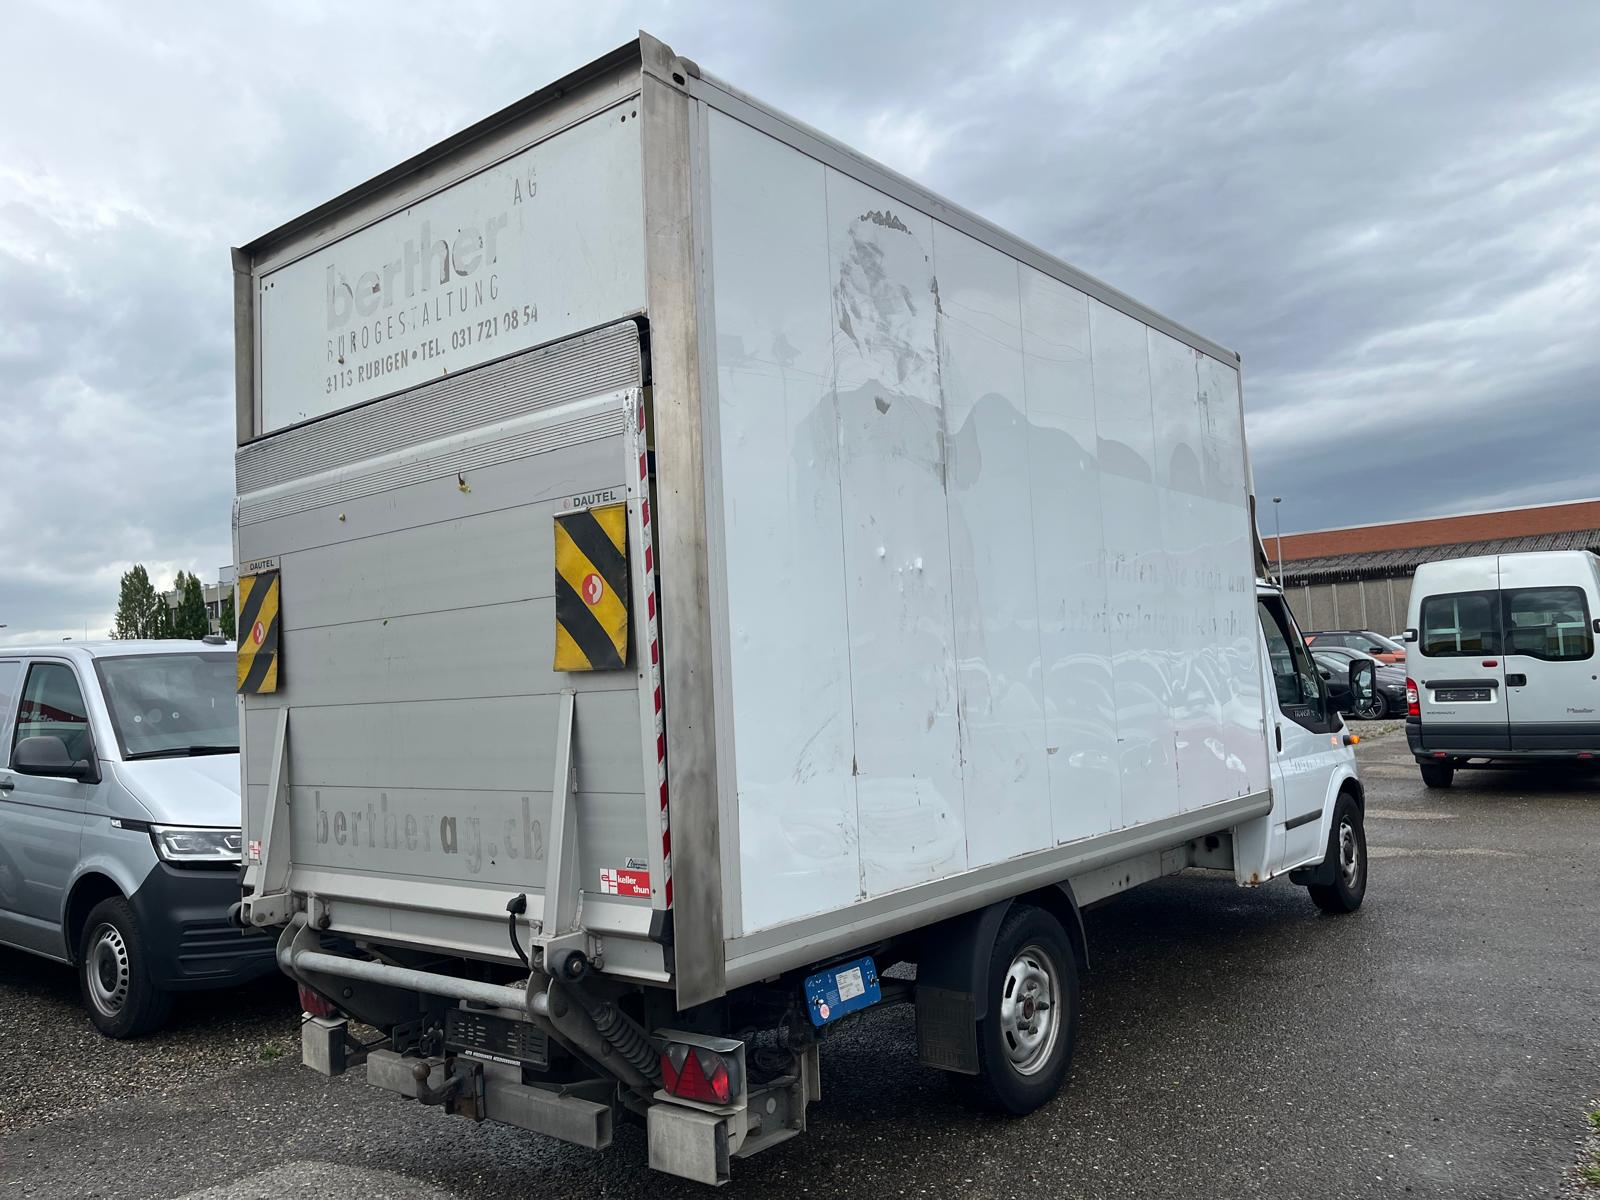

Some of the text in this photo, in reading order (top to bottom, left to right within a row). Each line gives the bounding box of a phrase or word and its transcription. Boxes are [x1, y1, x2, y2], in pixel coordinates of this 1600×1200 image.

[513, 168, 537, 205] AG
[325, 211, 508, 331] berther
[358, 349, 408, 383] RUBIGEN
[421, 337, 446, 361] TEL.
[452, 326, 472, 350] 031
[477, 317, 498, 342] 721
[504, 309, 519, 332] 08
[523, 303, 538, 326] 54
[572, 490, 617, 508] DAUTEL
[250, 560, 275, 571] DAUTEL
[315, 790, 544, 875] bertherag.ch
[617, 875, 637, 885] keller
[633, 885, 650, 895] thun
